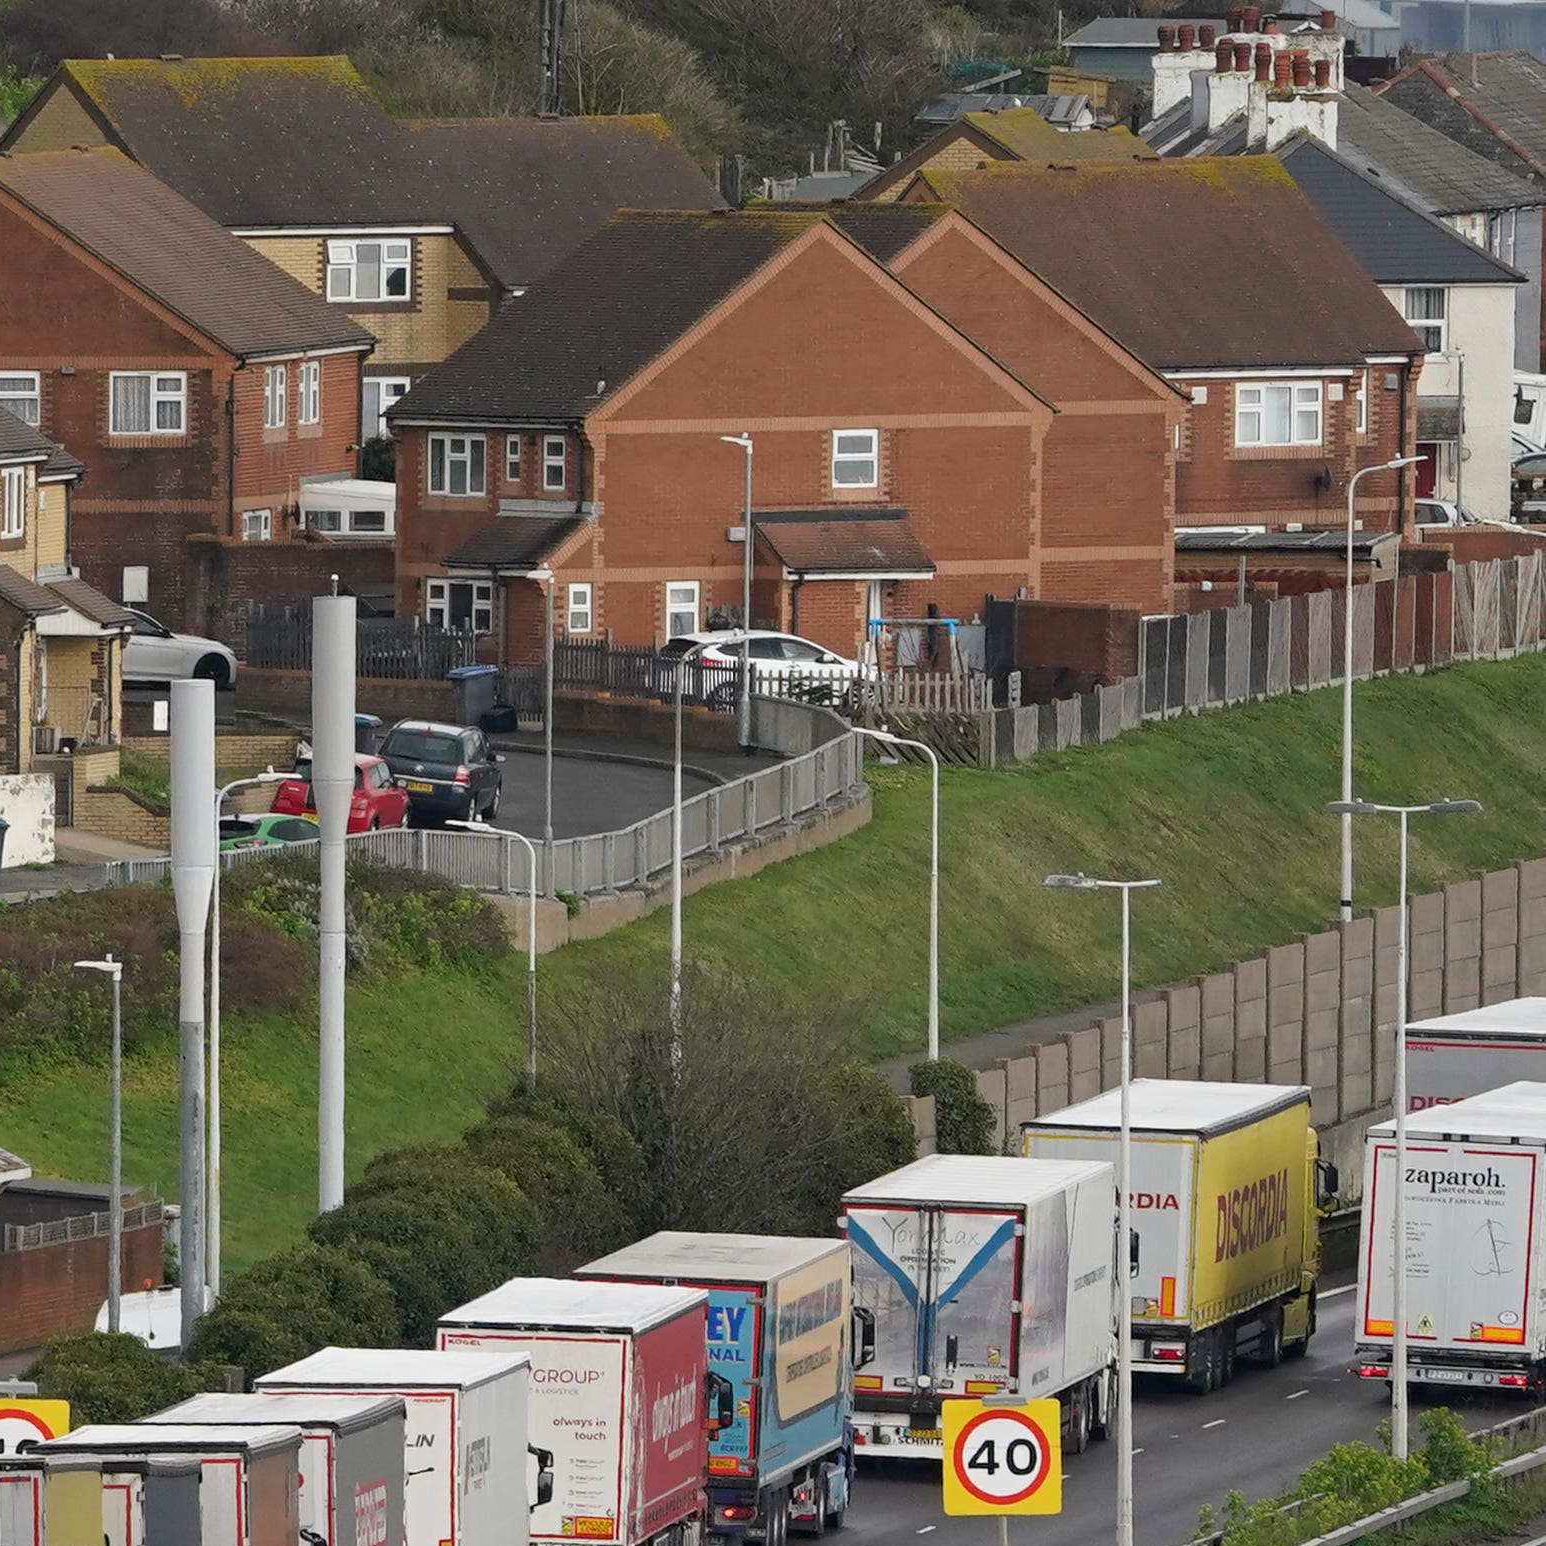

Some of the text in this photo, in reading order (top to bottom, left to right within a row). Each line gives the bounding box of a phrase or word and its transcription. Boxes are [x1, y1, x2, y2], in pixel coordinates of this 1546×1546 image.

[1215, 1168, 1289, 1263] DISCORDIA
[553, 1417, 606, 1428] always in
[575, 1431, 606, 1441] touch
[968, 1438, 1037, 1476] 40
